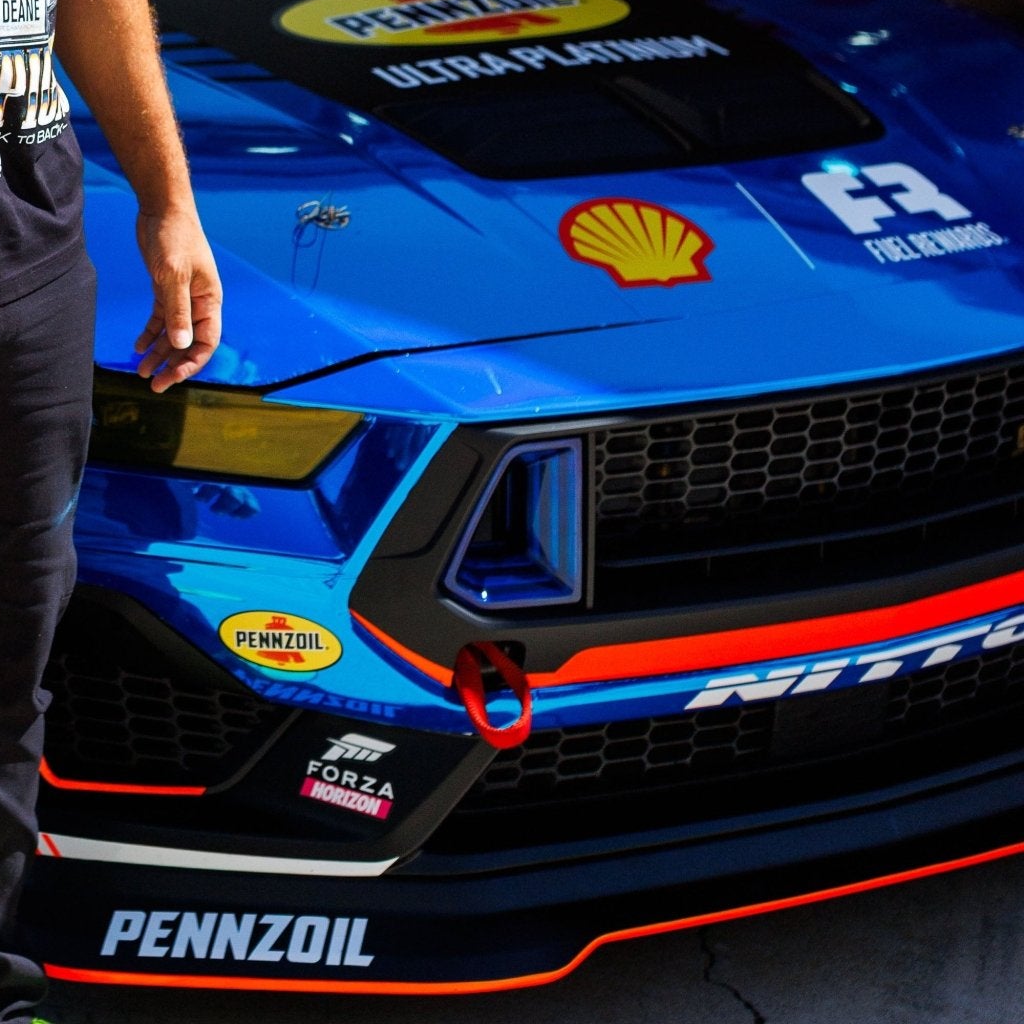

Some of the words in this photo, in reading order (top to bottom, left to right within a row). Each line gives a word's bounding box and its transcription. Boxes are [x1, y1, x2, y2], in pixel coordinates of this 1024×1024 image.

[372, 52, 525, 89] ULTRA
[509, 35, 730, 71] PLATINUM
[18, 134, 35, 145] TO
[36, 123, 64, 144] BACK
[863, 236, 921, 264] FUEL
[235, 631, 323, 650] PENNZOIL
[306, 760, 394, 799] FORZA
[310, 782, 382, 816] HORIZON
[100, 910, 375, 967] PENNZOIL
